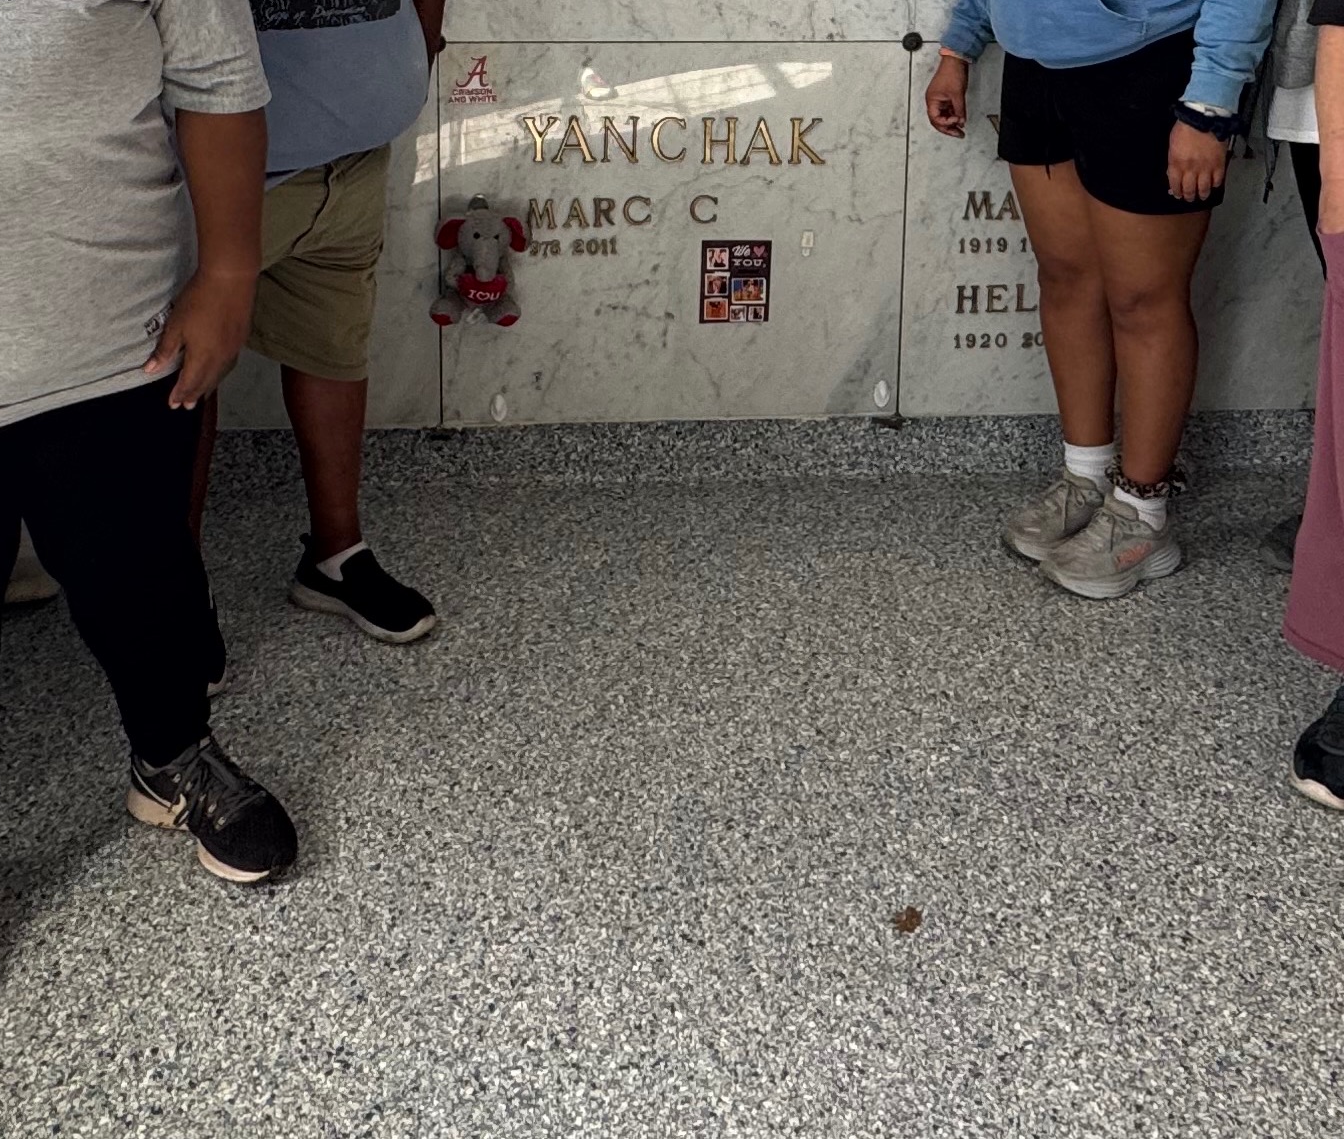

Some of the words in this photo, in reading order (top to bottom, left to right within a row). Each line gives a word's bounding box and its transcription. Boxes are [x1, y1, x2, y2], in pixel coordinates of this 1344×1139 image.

[448, 95, 467, 103] AND
[469, 95, 498, 103] WHITE
[523, 116, 826, 165] YANCHAK
[528, 195, 652, 230] MARC
[689, 195, 719, 224] C
[962, 190, 1020, 220] MA
[572, 236, 618, 256] 2011
[959, 237, 1008, 254] 1919
[956, 284, 1038, 314] HEL
[954, 332, 1008, 349] 1920
[1022, 331, 1044, 349] 20
